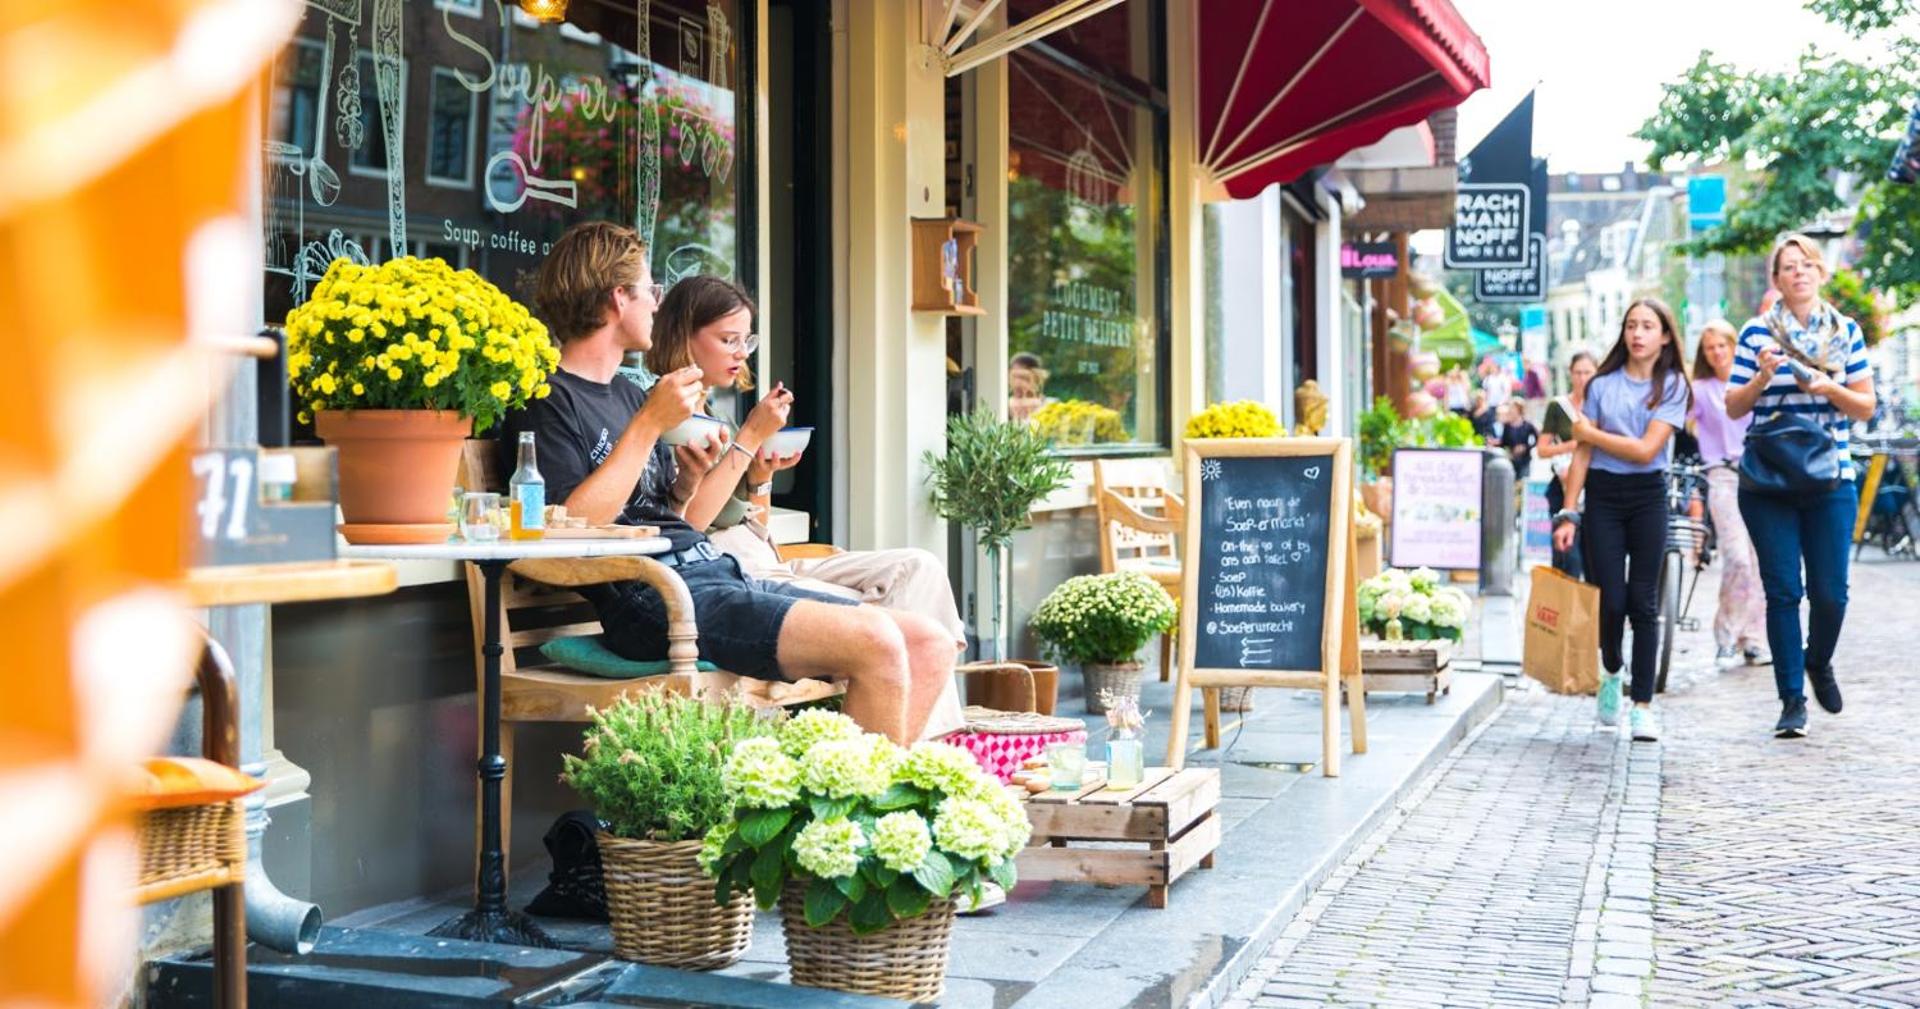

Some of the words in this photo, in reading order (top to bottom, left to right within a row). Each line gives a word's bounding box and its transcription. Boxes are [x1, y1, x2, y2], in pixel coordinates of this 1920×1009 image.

[1455, 193, 1520, 211] RACH
[1455, 211, 1520, 228] MANI
[443, 218, 485, 252] Soup,
[490, 229, 537, 256] coffee
[1455, 228, 1519, 245] NOFF
[1484, 268, 1537, 283] NOFF
[1043, 309, 1080, 341] PETIT
[1242, 554, 1261, 565] aan
